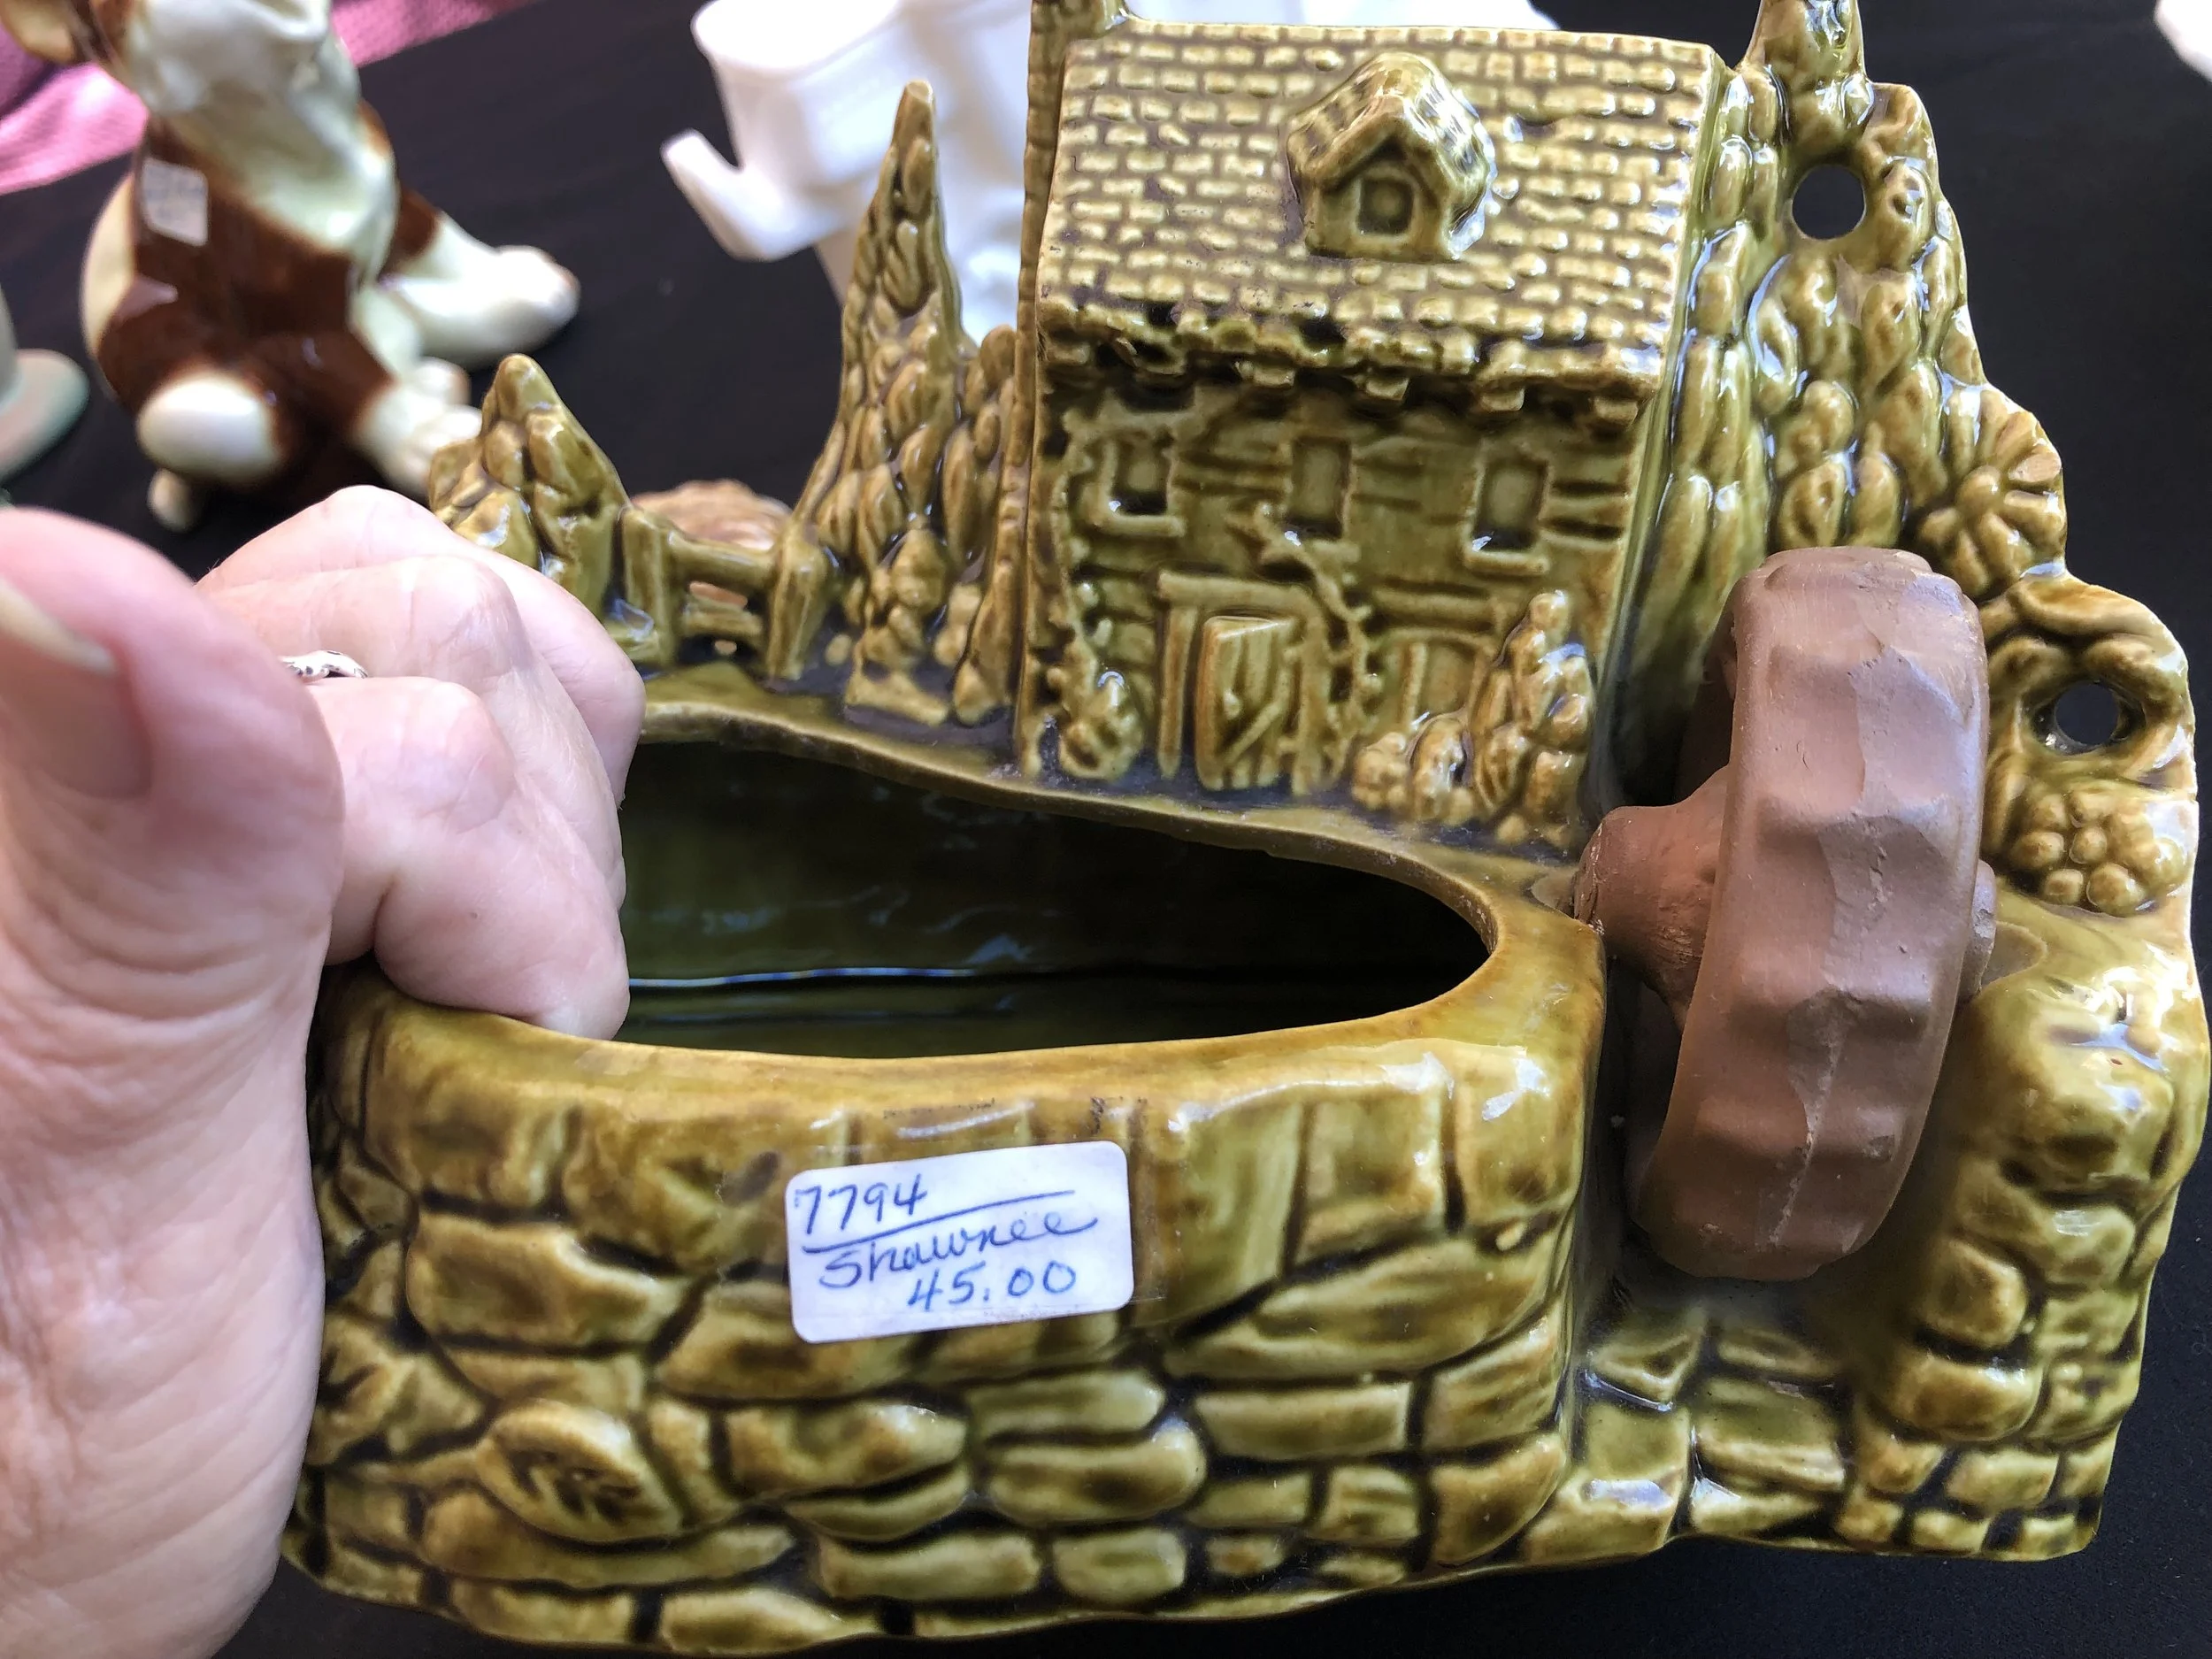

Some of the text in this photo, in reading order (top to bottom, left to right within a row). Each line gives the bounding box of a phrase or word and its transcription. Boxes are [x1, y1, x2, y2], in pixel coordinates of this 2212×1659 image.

[795, 1173, 927, 1235] 7794
[819, 1210, 1099, 1289] Shawnee
[908, 1260, 1077, 1310] 45.00
